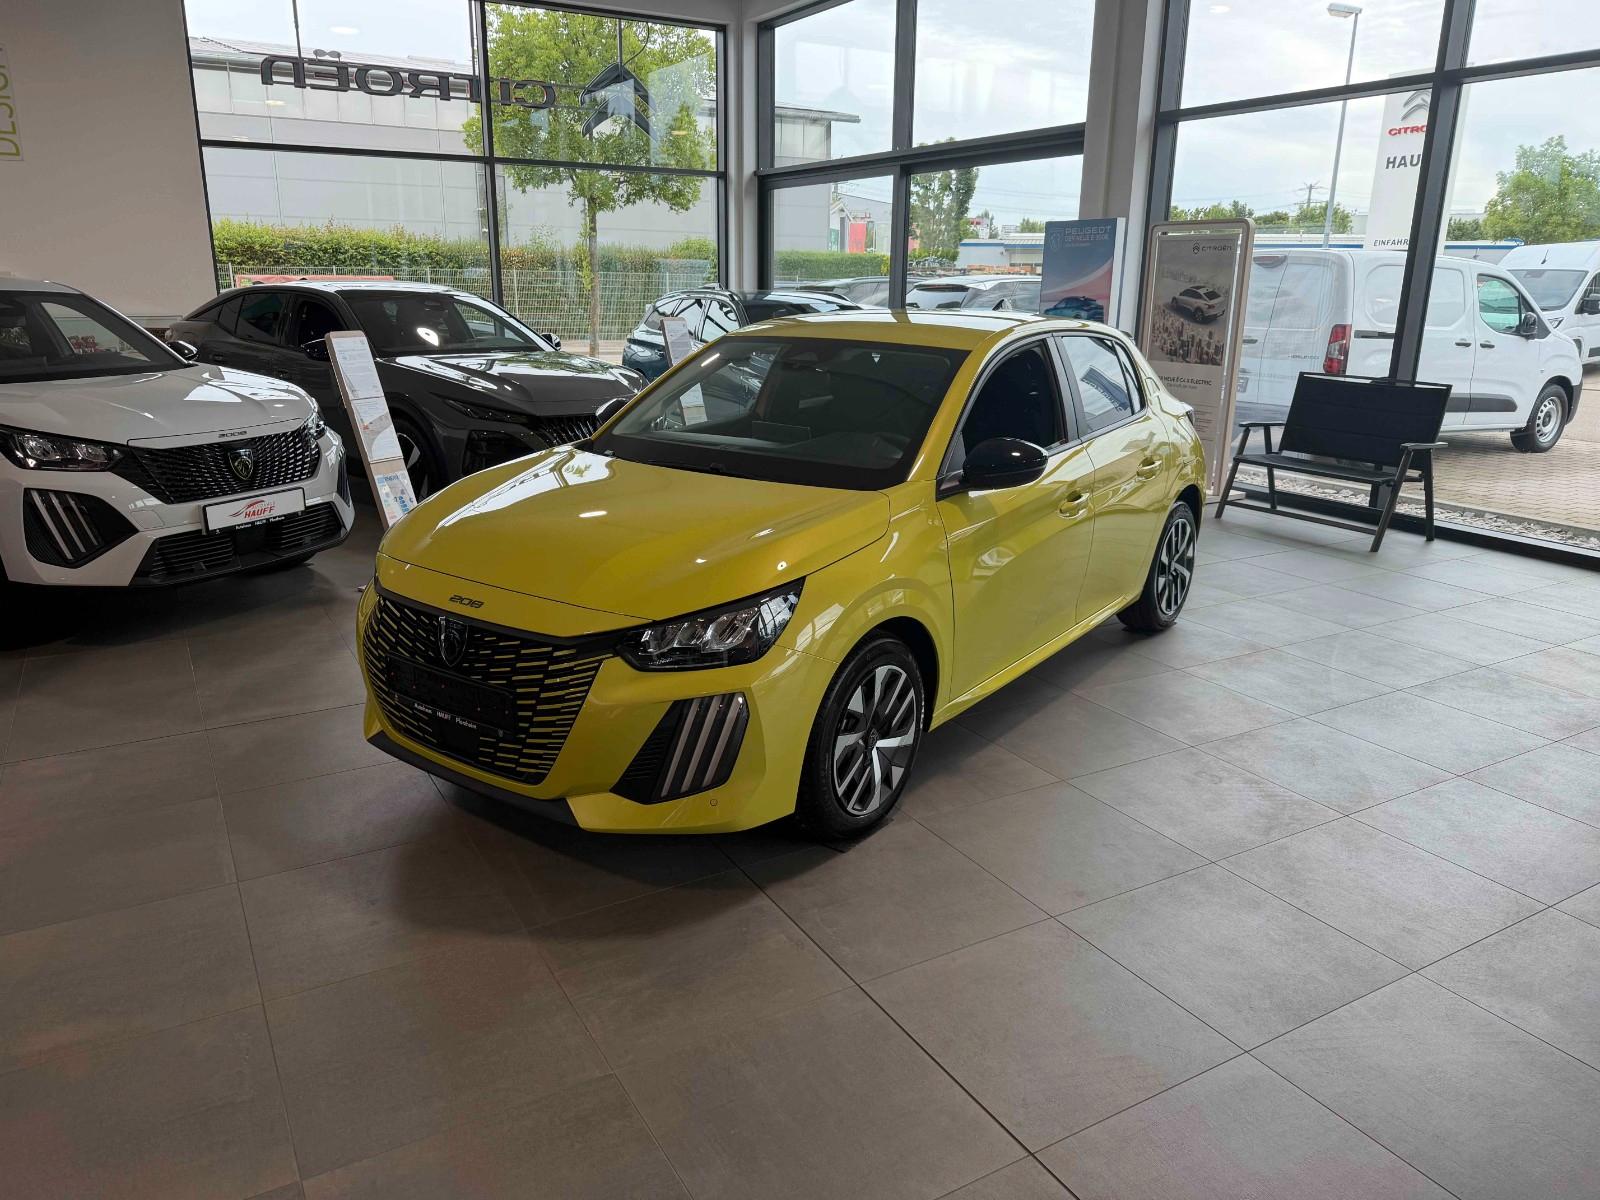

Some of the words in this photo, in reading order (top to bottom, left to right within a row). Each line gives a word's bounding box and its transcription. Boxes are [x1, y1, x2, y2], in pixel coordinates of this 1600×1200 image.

[1388, 124, 1427, 137] CITRO
[1385, 153, 1423, 170] HAU
[1065, 225, 1112, 236] PEUGEOT
[1373, 238, 1409, 248] EINFAHR
[244, 505, 275, 519] HAUFF
[449, 595, 484, 608] 208
